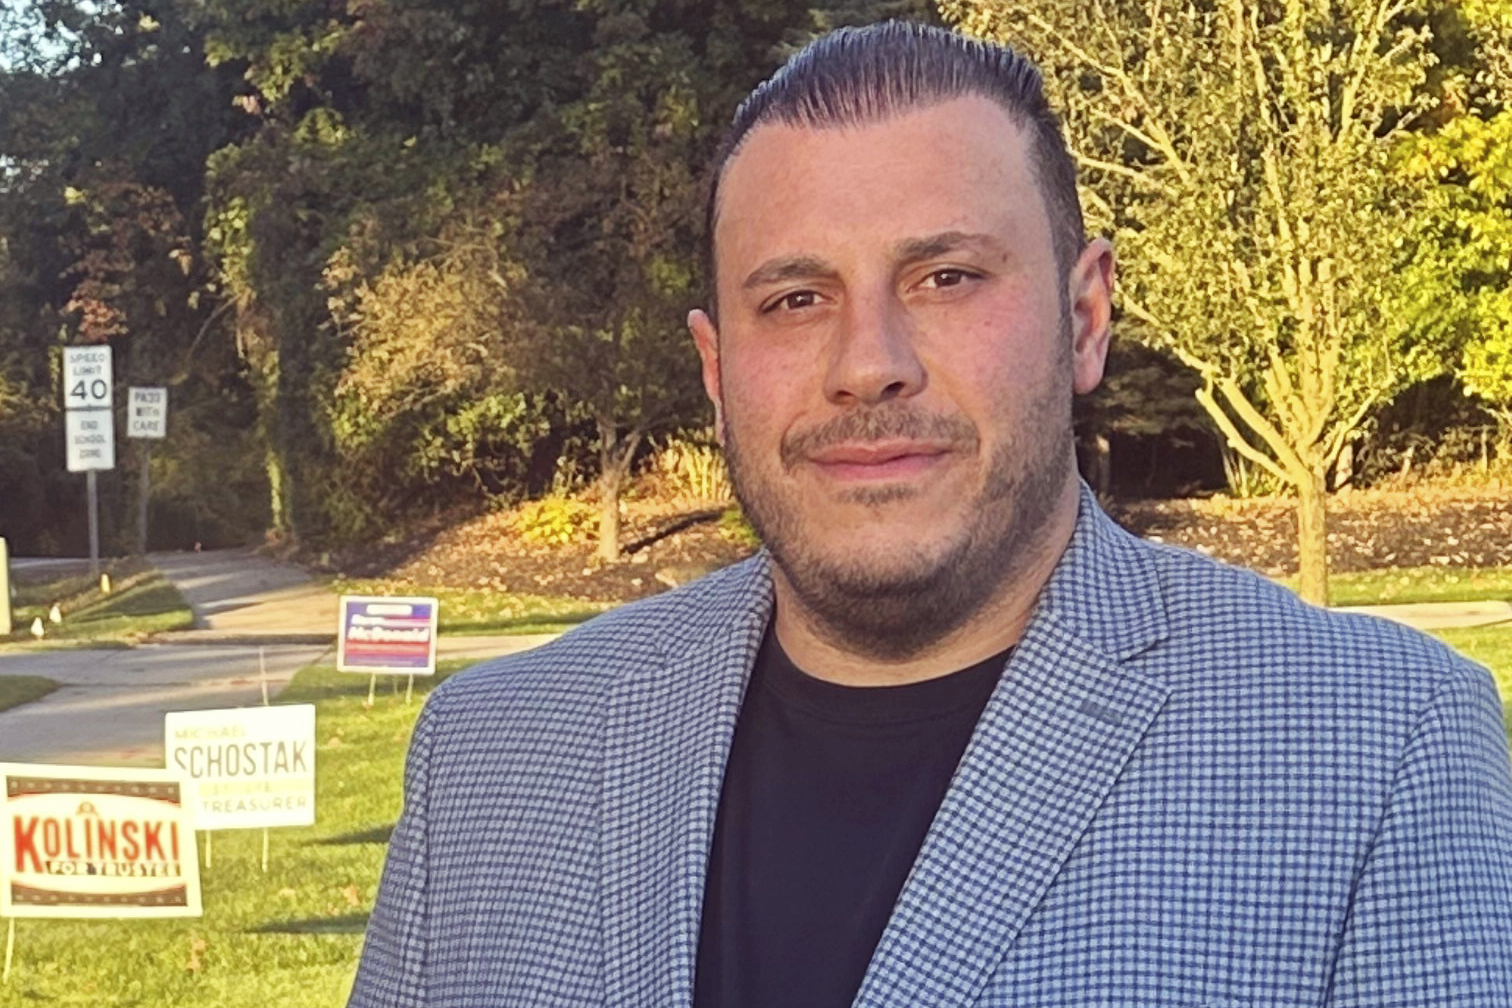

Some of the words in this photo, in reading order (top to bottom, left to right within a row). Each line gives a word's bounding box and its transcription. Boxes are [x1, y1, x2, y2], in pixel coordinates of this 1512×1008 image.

[70, 353, 106, 363] SPEED
[73, 365, 102, 376] LIMIT
[70, 378, 107, 400] 40
[134, 392, 161, 403] PASS
[133, 420, 159, 431] CARE
[174, 740, 307, 779] SCHOSTAK
[202, 795, 307, 813] TREASURER
[13, 815, 180, 874] KOLINSKI
[49, 860, 91, 875] FOR
[93, 861, 180, 877] TRUSTEE
